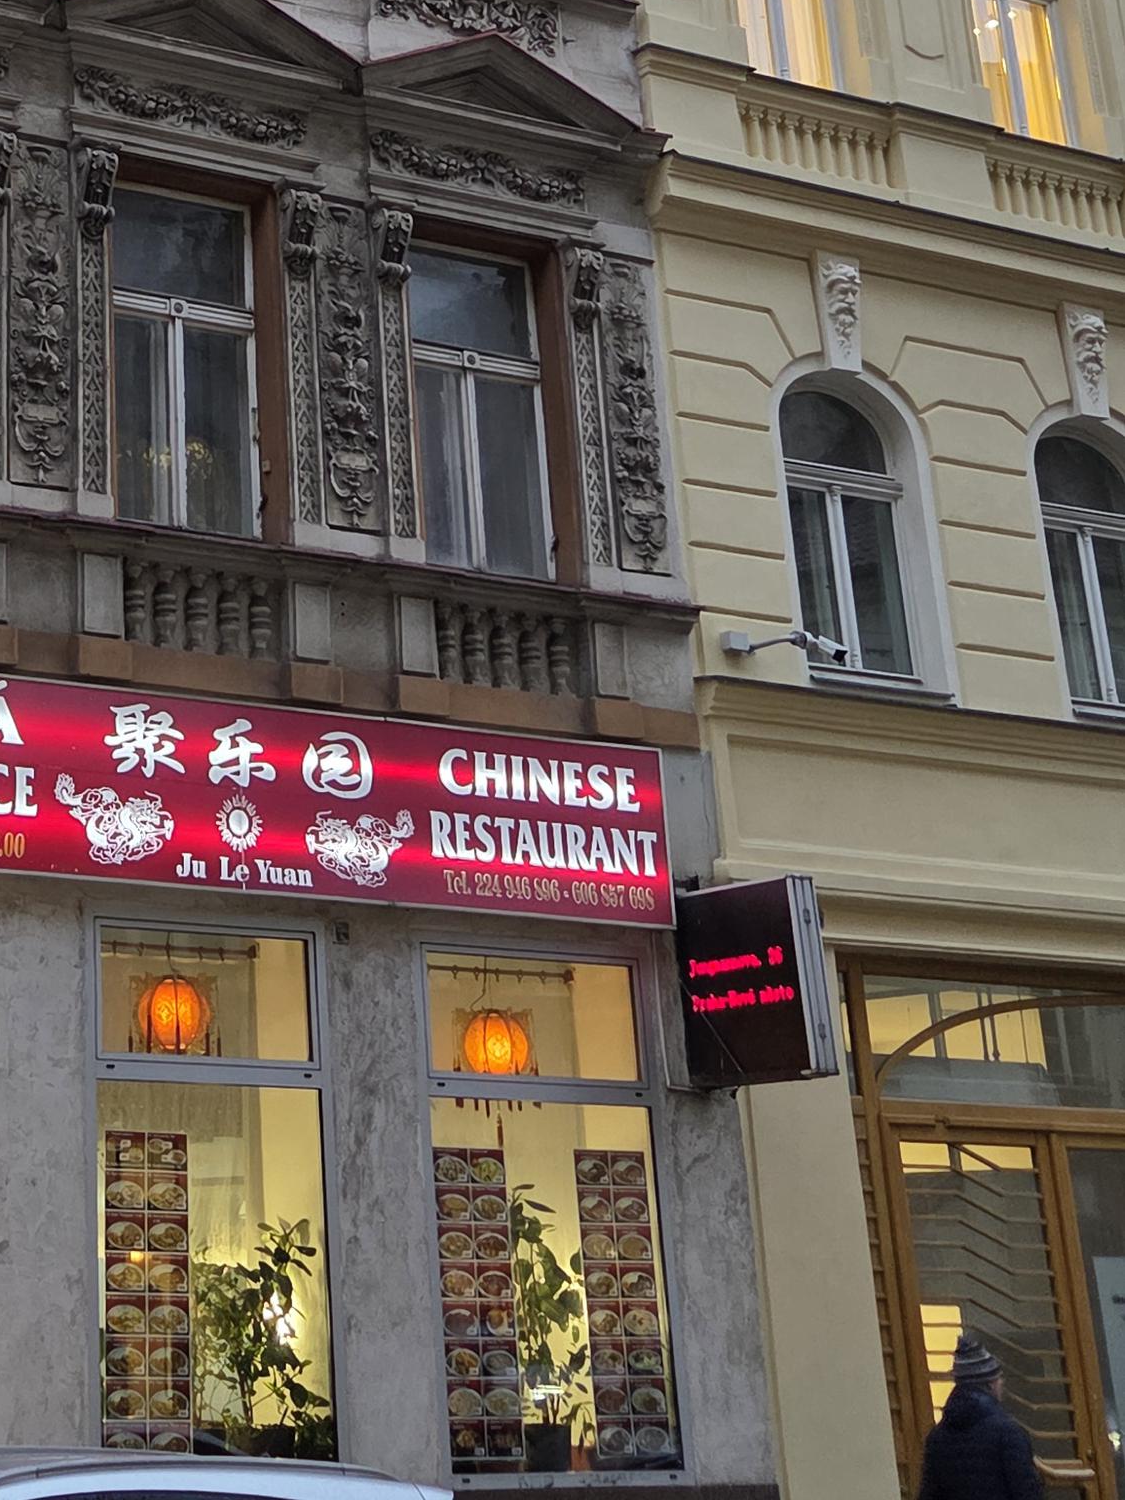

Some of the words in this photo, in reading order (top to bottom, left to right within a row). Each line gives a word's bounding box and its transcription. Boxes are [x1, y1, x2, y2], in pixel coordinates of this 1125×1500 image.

[438, 748, 641, 813] CHINESE
[429, 810, 657, 877] RESTAURANT
[176, 852, 207, 878] Ju
[219, 856, 250, 882] Le
[254, 859, 314, 887] Yuan
[443, 869, 472, 894] Tel.
[474, 872, 502, 897] 224
[504, 875, 531, 900] 946
[571, 881, 599, 906] 606
